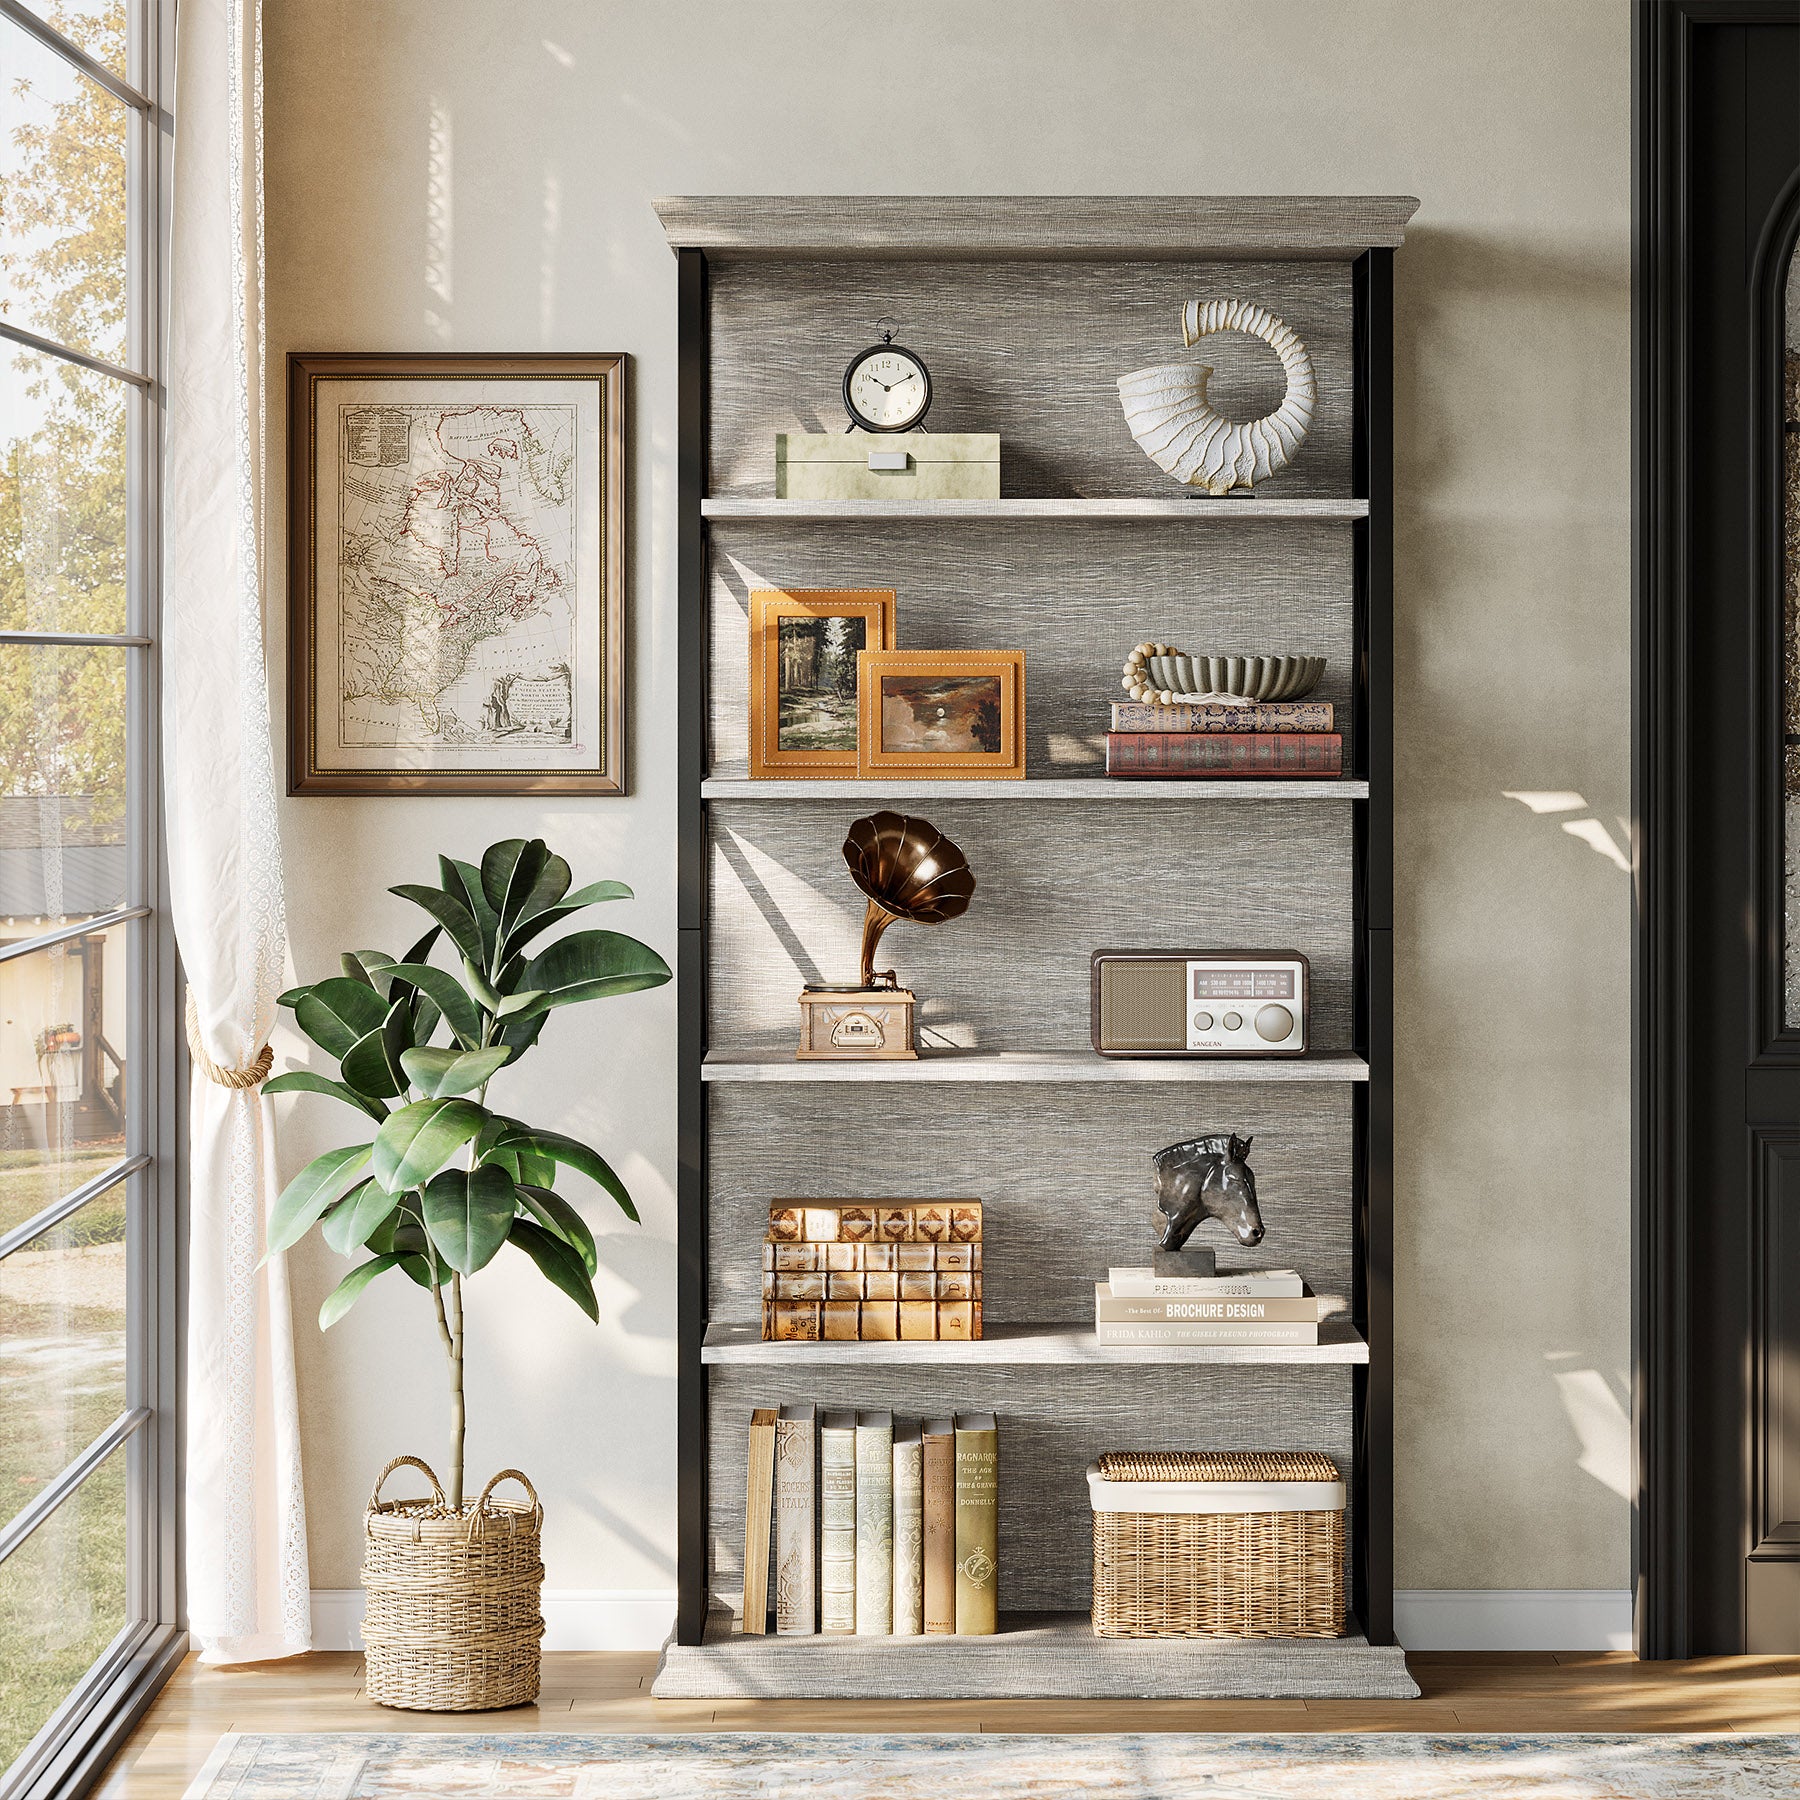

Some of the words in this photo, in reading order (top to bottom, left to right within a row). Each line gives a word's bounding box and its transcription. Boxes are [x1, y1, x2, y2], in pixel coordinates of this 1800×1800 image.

[870, 364, 879, 372] 11
[882, 360, 891, 369] 12
[1166, 1304, 1224, 1318] BROCHURE
[1226, 1304, 1265, 1318] DESIGN
[1106, 1330, 1135, 1339] FRIDA
[1138, 1330, 1171, 1339] KAHLO
